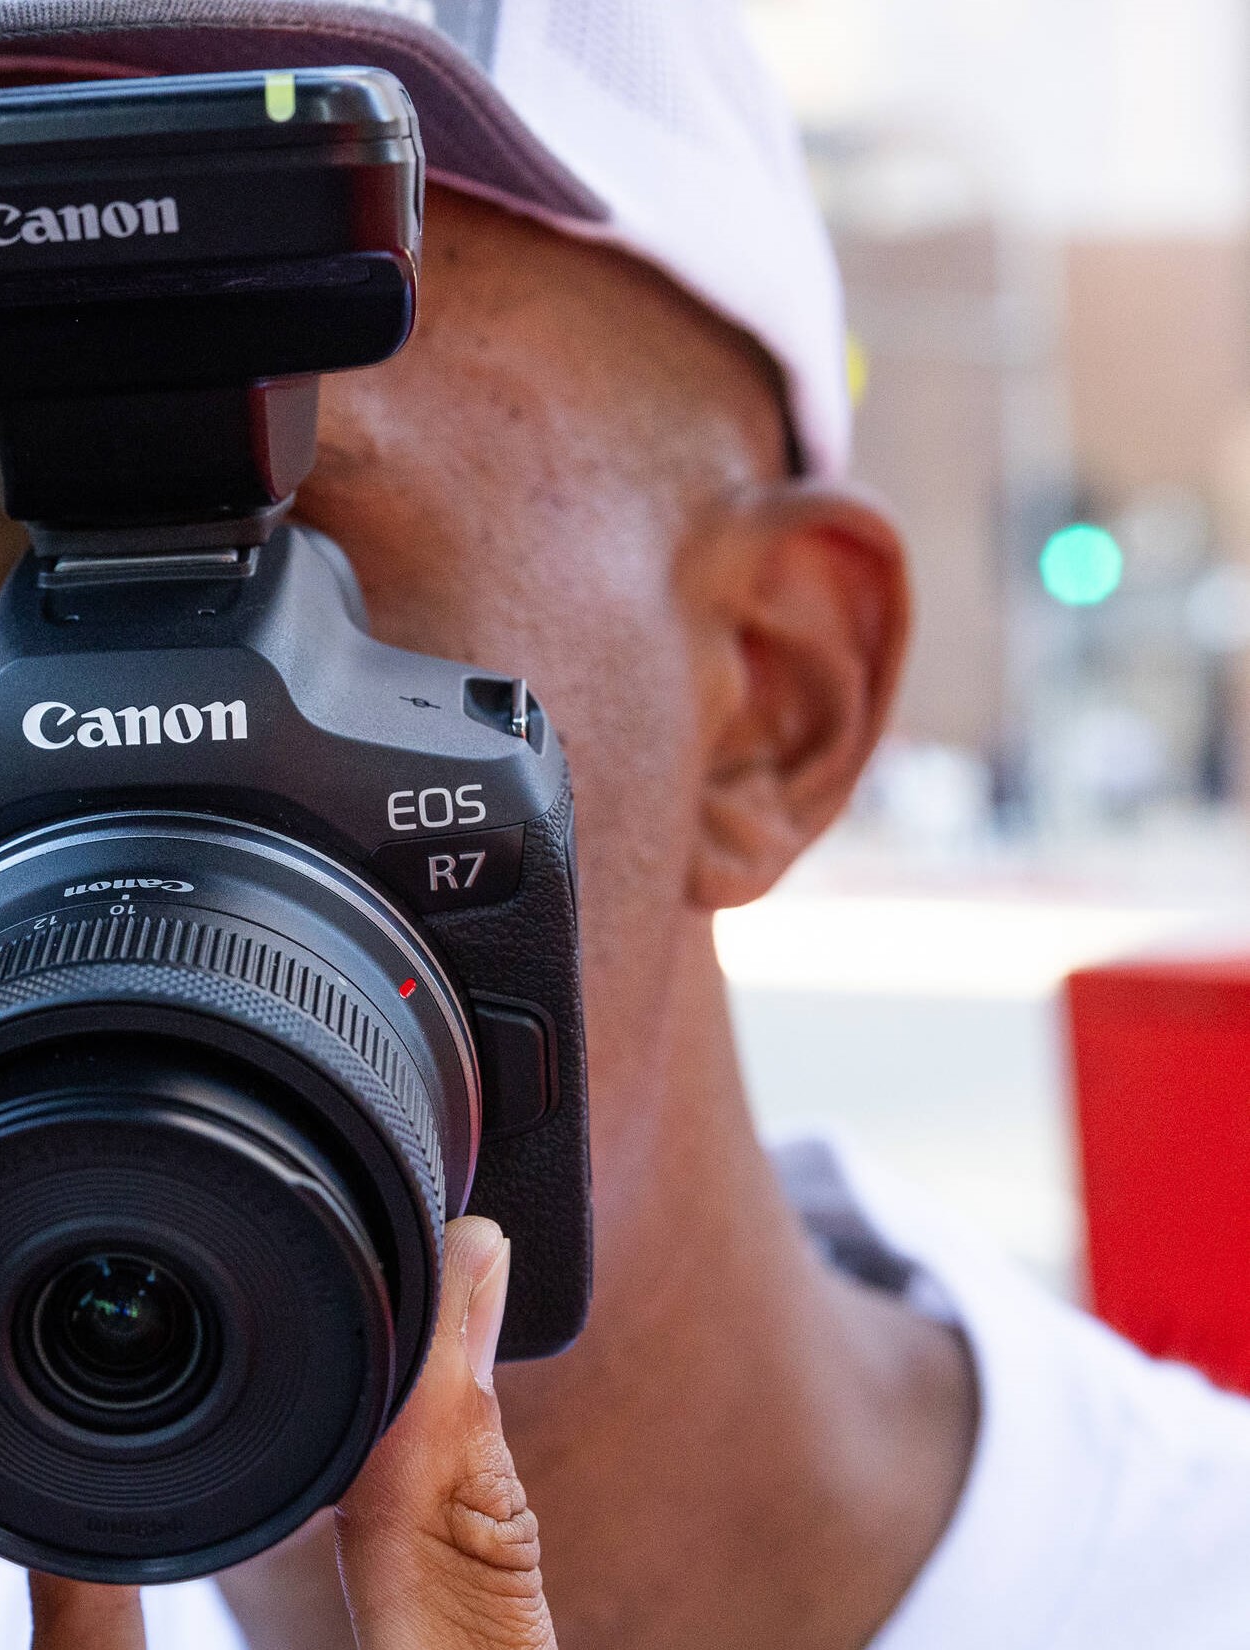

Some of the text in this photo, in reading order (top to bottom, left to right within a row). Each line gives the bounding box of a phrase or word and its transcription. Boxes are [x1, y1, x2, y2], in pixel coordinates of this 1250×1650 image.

[22, 700, 248, 749] Canon
[388, 784, 486, 830] EOS
[429, 851, 486, 891] R7
[64, 878, 194, 897] Canon
[33, 915, 57, 930] 12
[110, 904, 136, 916] 10
